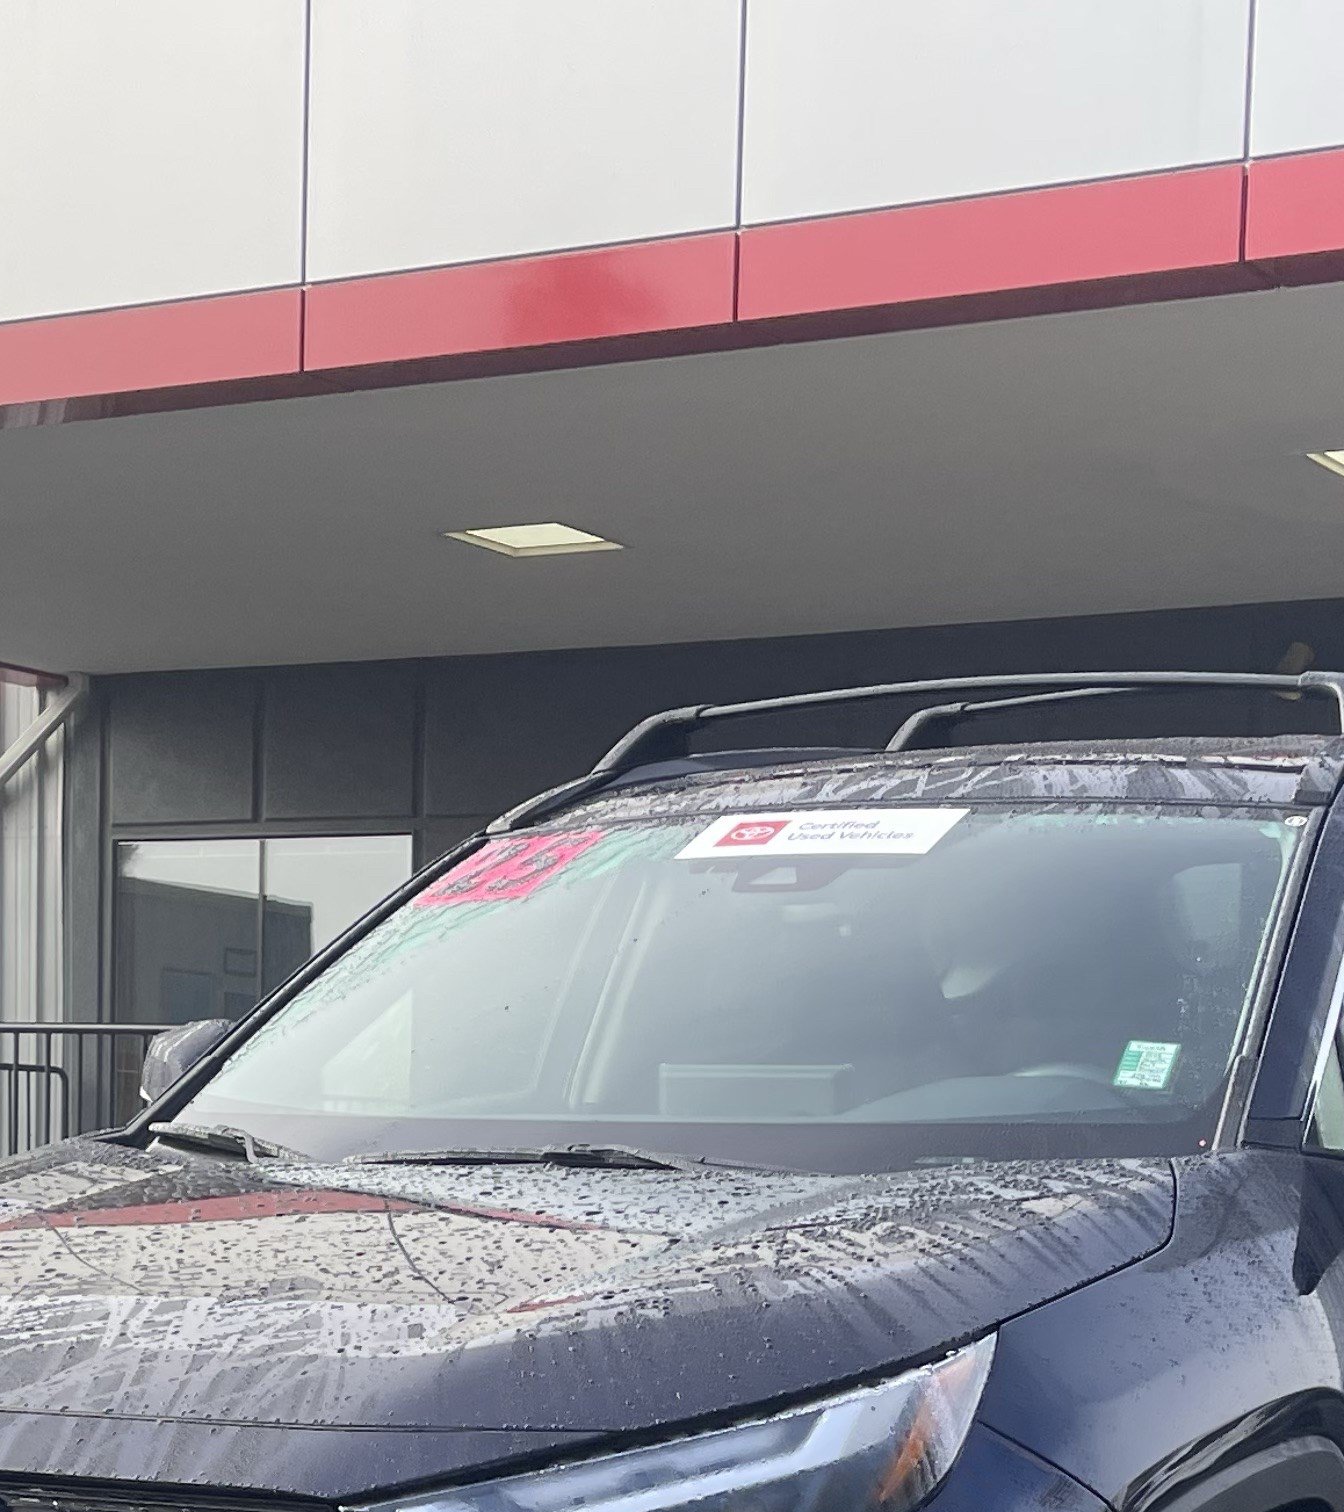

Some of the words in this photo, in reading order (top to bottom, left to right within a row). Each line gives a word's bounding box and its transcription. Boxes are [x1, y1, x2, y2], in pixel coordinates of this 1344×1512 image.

[799, 820, 881, 831] Certified
[787, 831, 836, 841] Used
[839, 831, 915, 840] Vehicles
